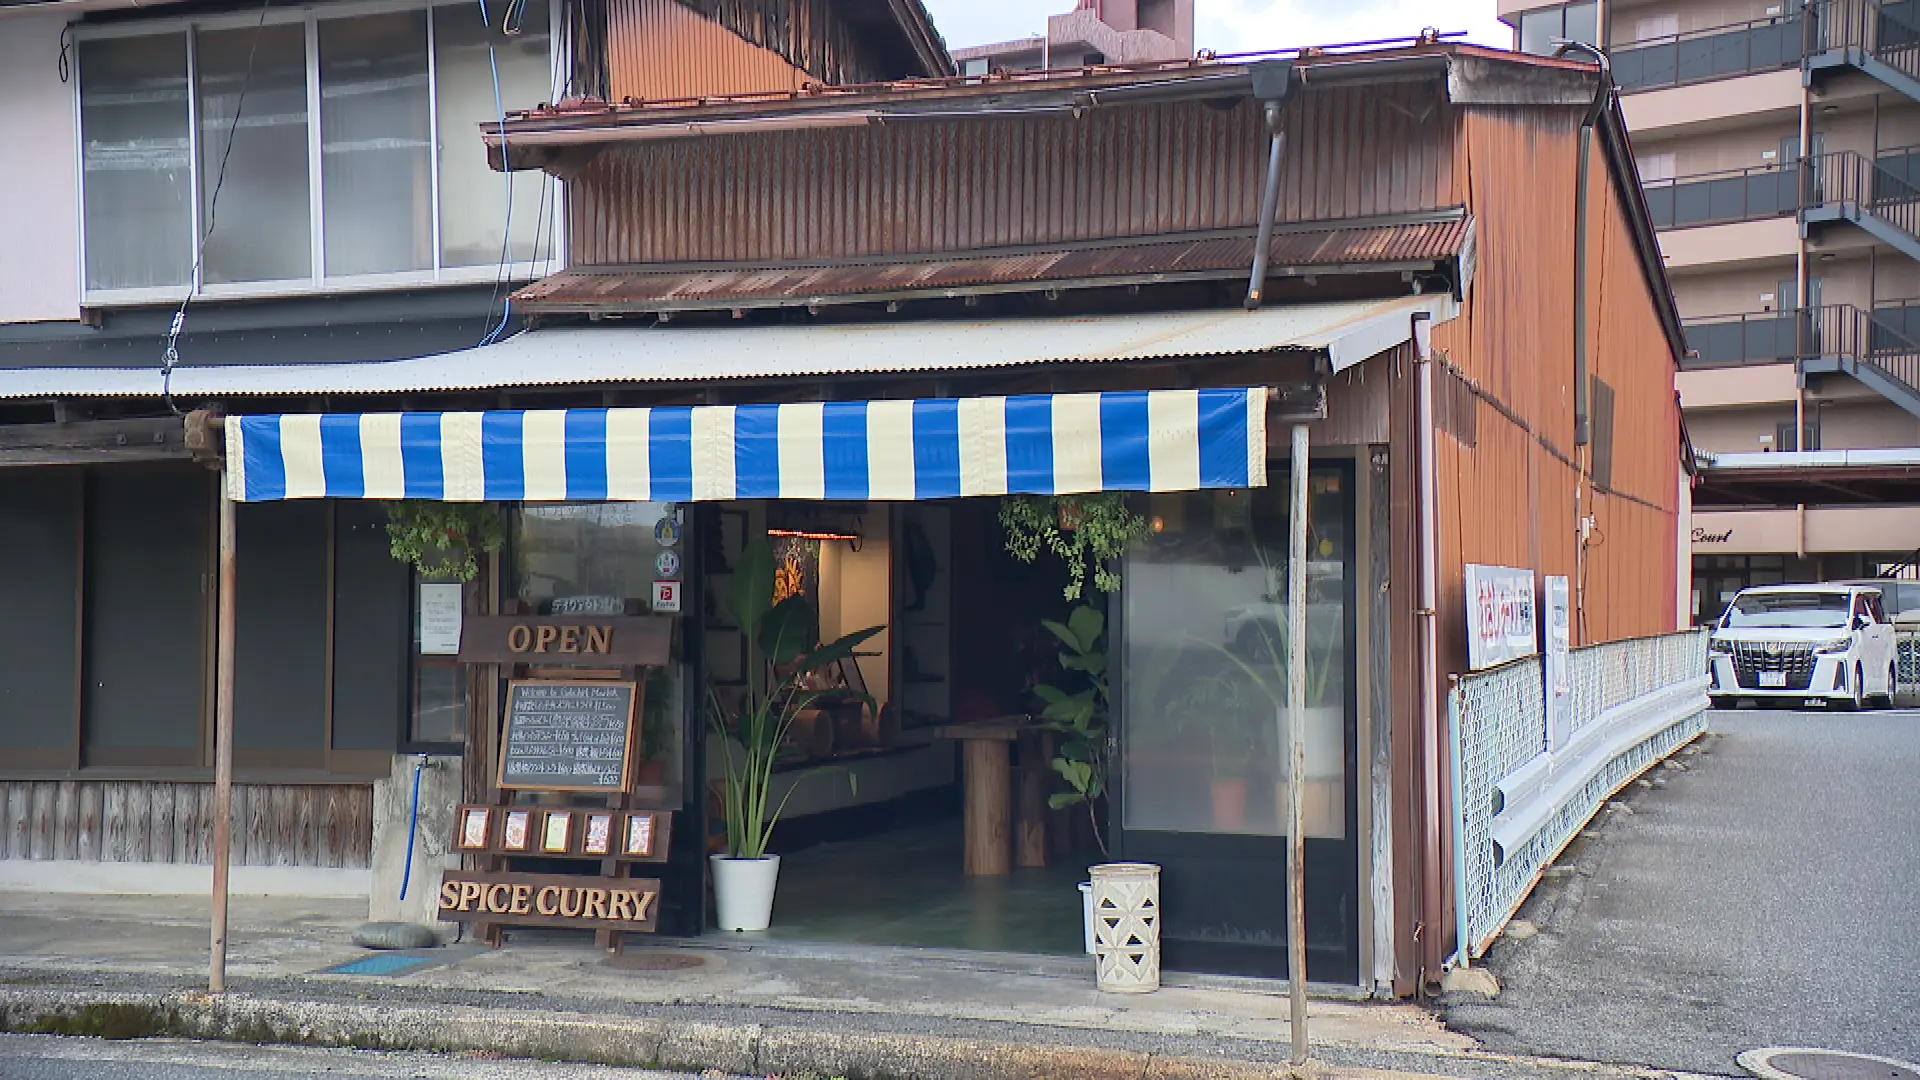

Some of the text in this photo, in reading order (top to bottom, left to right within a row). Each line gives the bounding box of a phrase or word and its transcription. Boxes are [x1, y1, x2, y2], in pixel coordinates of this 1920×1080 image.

[508, 625, 612, 654] OPEN
[440, 880, 657, 921] SPICE CURRY
